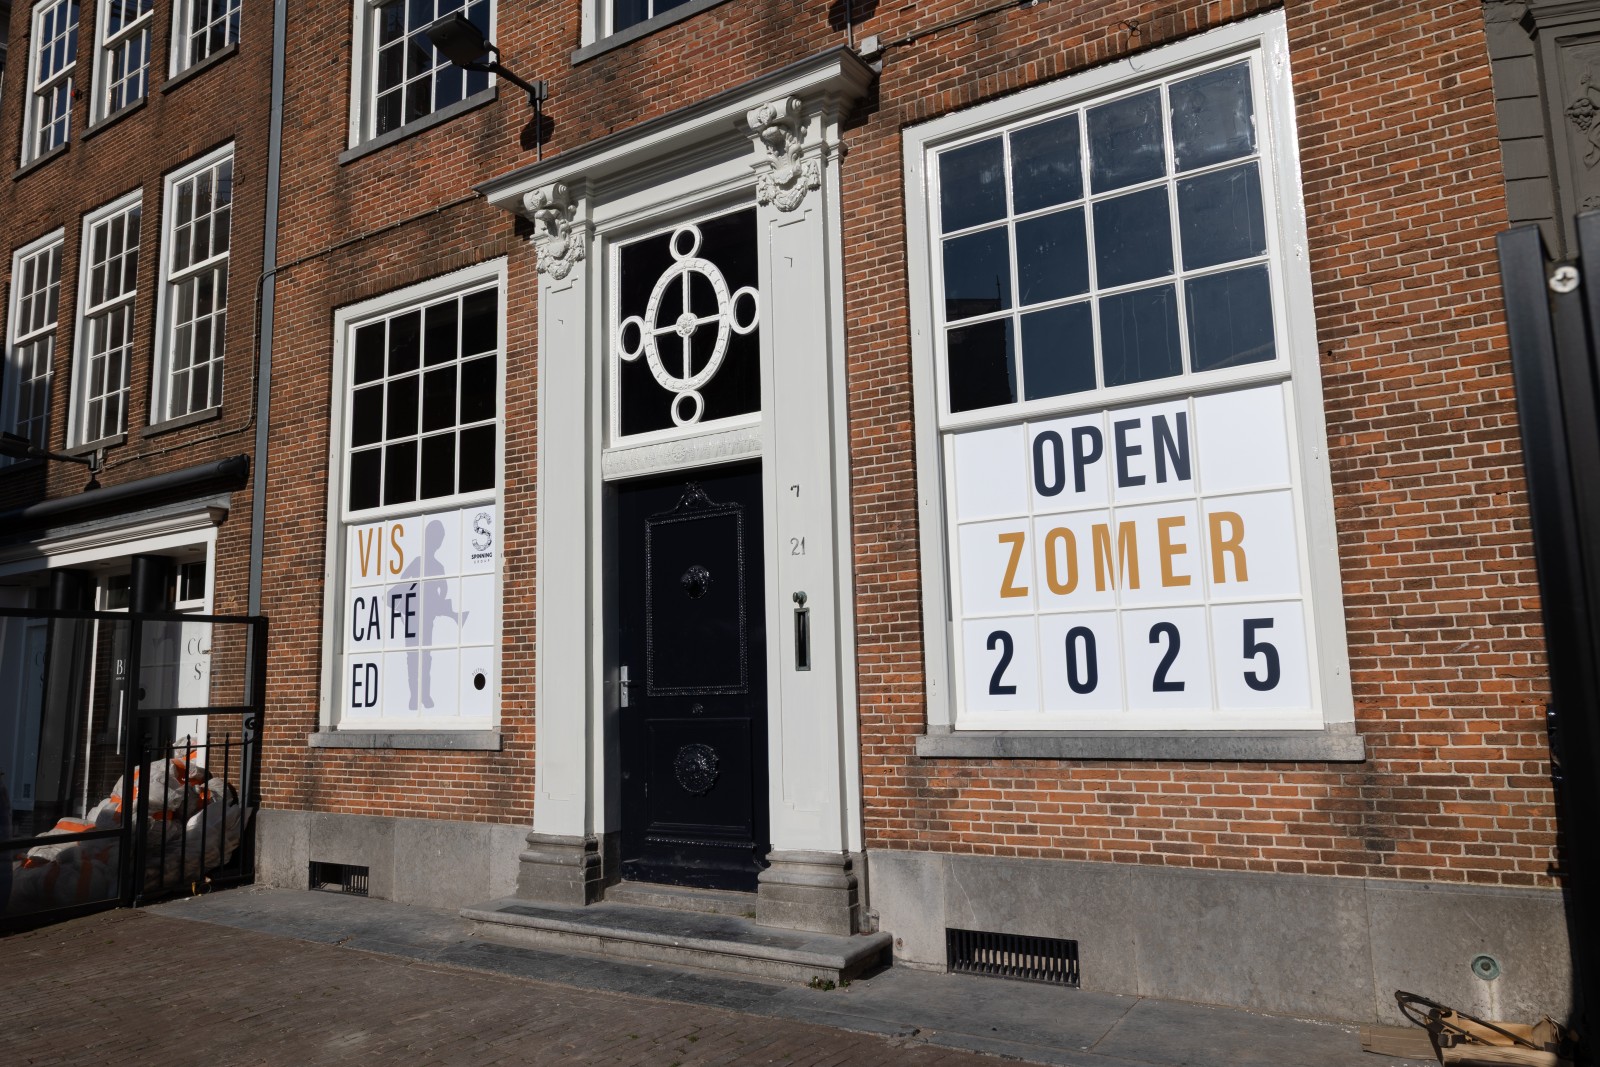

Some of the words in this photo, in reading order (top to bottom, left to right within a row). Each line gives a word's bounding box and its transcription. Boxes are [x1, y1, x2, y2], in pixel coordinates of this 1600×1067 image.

[1032, 411, 1192, 497] OPEN
[358, 523, 404, 578] VIS
[789, 536, 806, 556] 21
[998, 511, 1249, 599] ZOMER
[352, 583, 418, 642] CAFÉ
[351, 662, 379, 708] ED
[986, 617, 1281, 696] 2025
